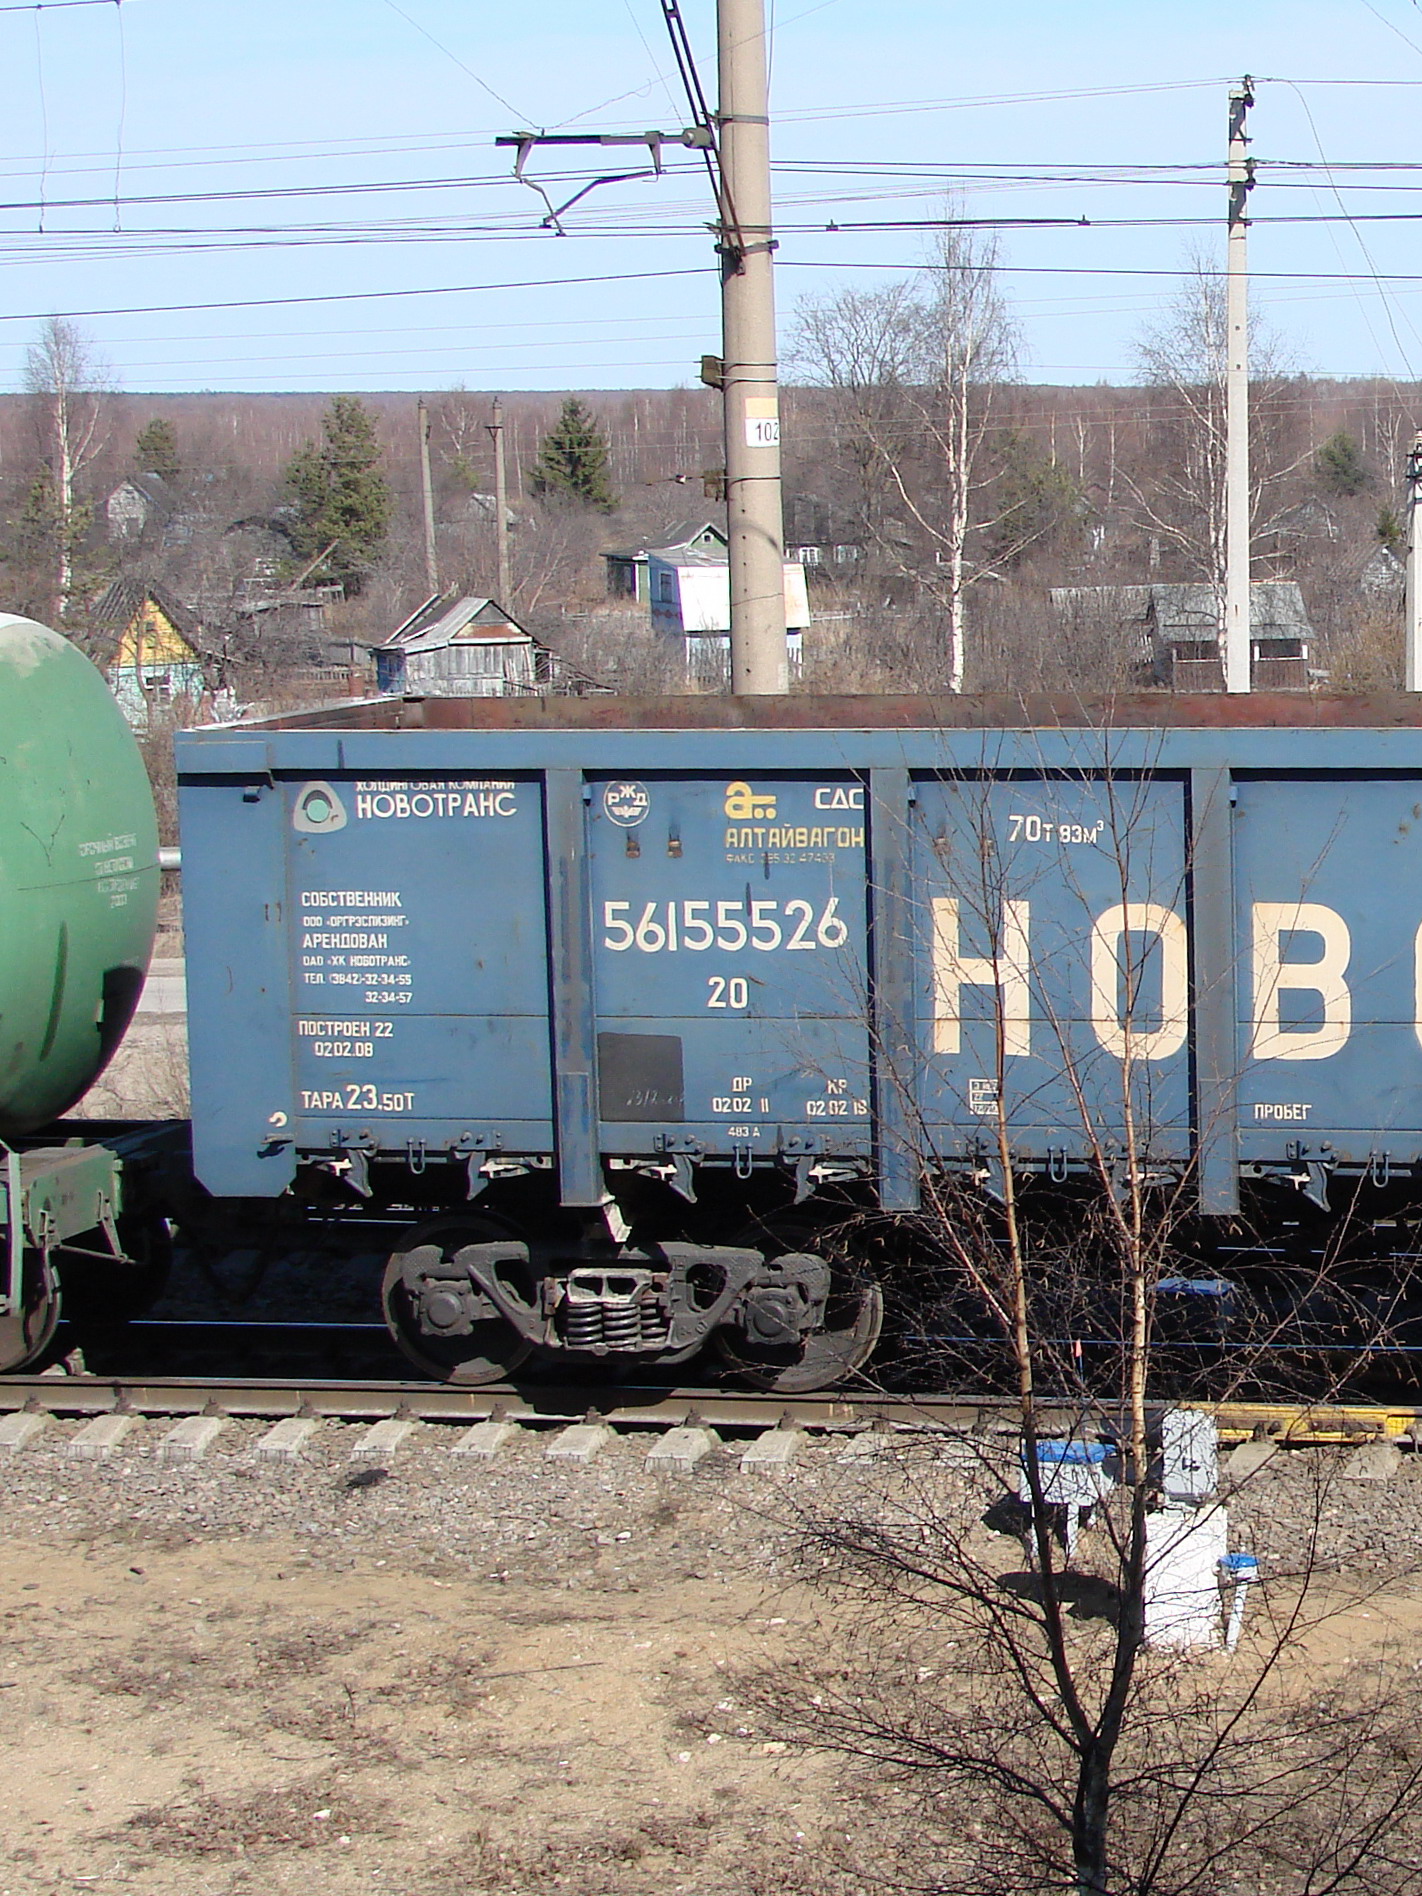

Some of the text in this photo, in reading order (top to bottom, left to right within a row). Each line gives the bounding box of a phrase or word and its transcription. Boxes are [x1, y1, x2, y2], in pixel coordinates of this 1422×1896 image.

[357, 792, 517, 818] НОВОТРАНС
[725, 823, 864, 848] АЛТАЙВАГОН
[301, 891, 402, 907] СОБСТВЕННИК
[303, 916, 323, 927] ООО
[604, 898, 849, 952] 56155526
[303, 933, 388, 949] АРЕНДОВАН
[303, 956, 324, 967] ОАО
[365, 991, 413, 1004] 32-34-57
[707, 976, 749, 1009] 20
[299, 1020, 394, 1037] ПОСТРОЕН 22
[732, 1076, 753, 1093] ДР
[827, 1078, 848, 1095] КР
[301, 1091, 344, 1109] ТАРА
[1255, 1104, 1312, 1121] ПРОБЕГ
